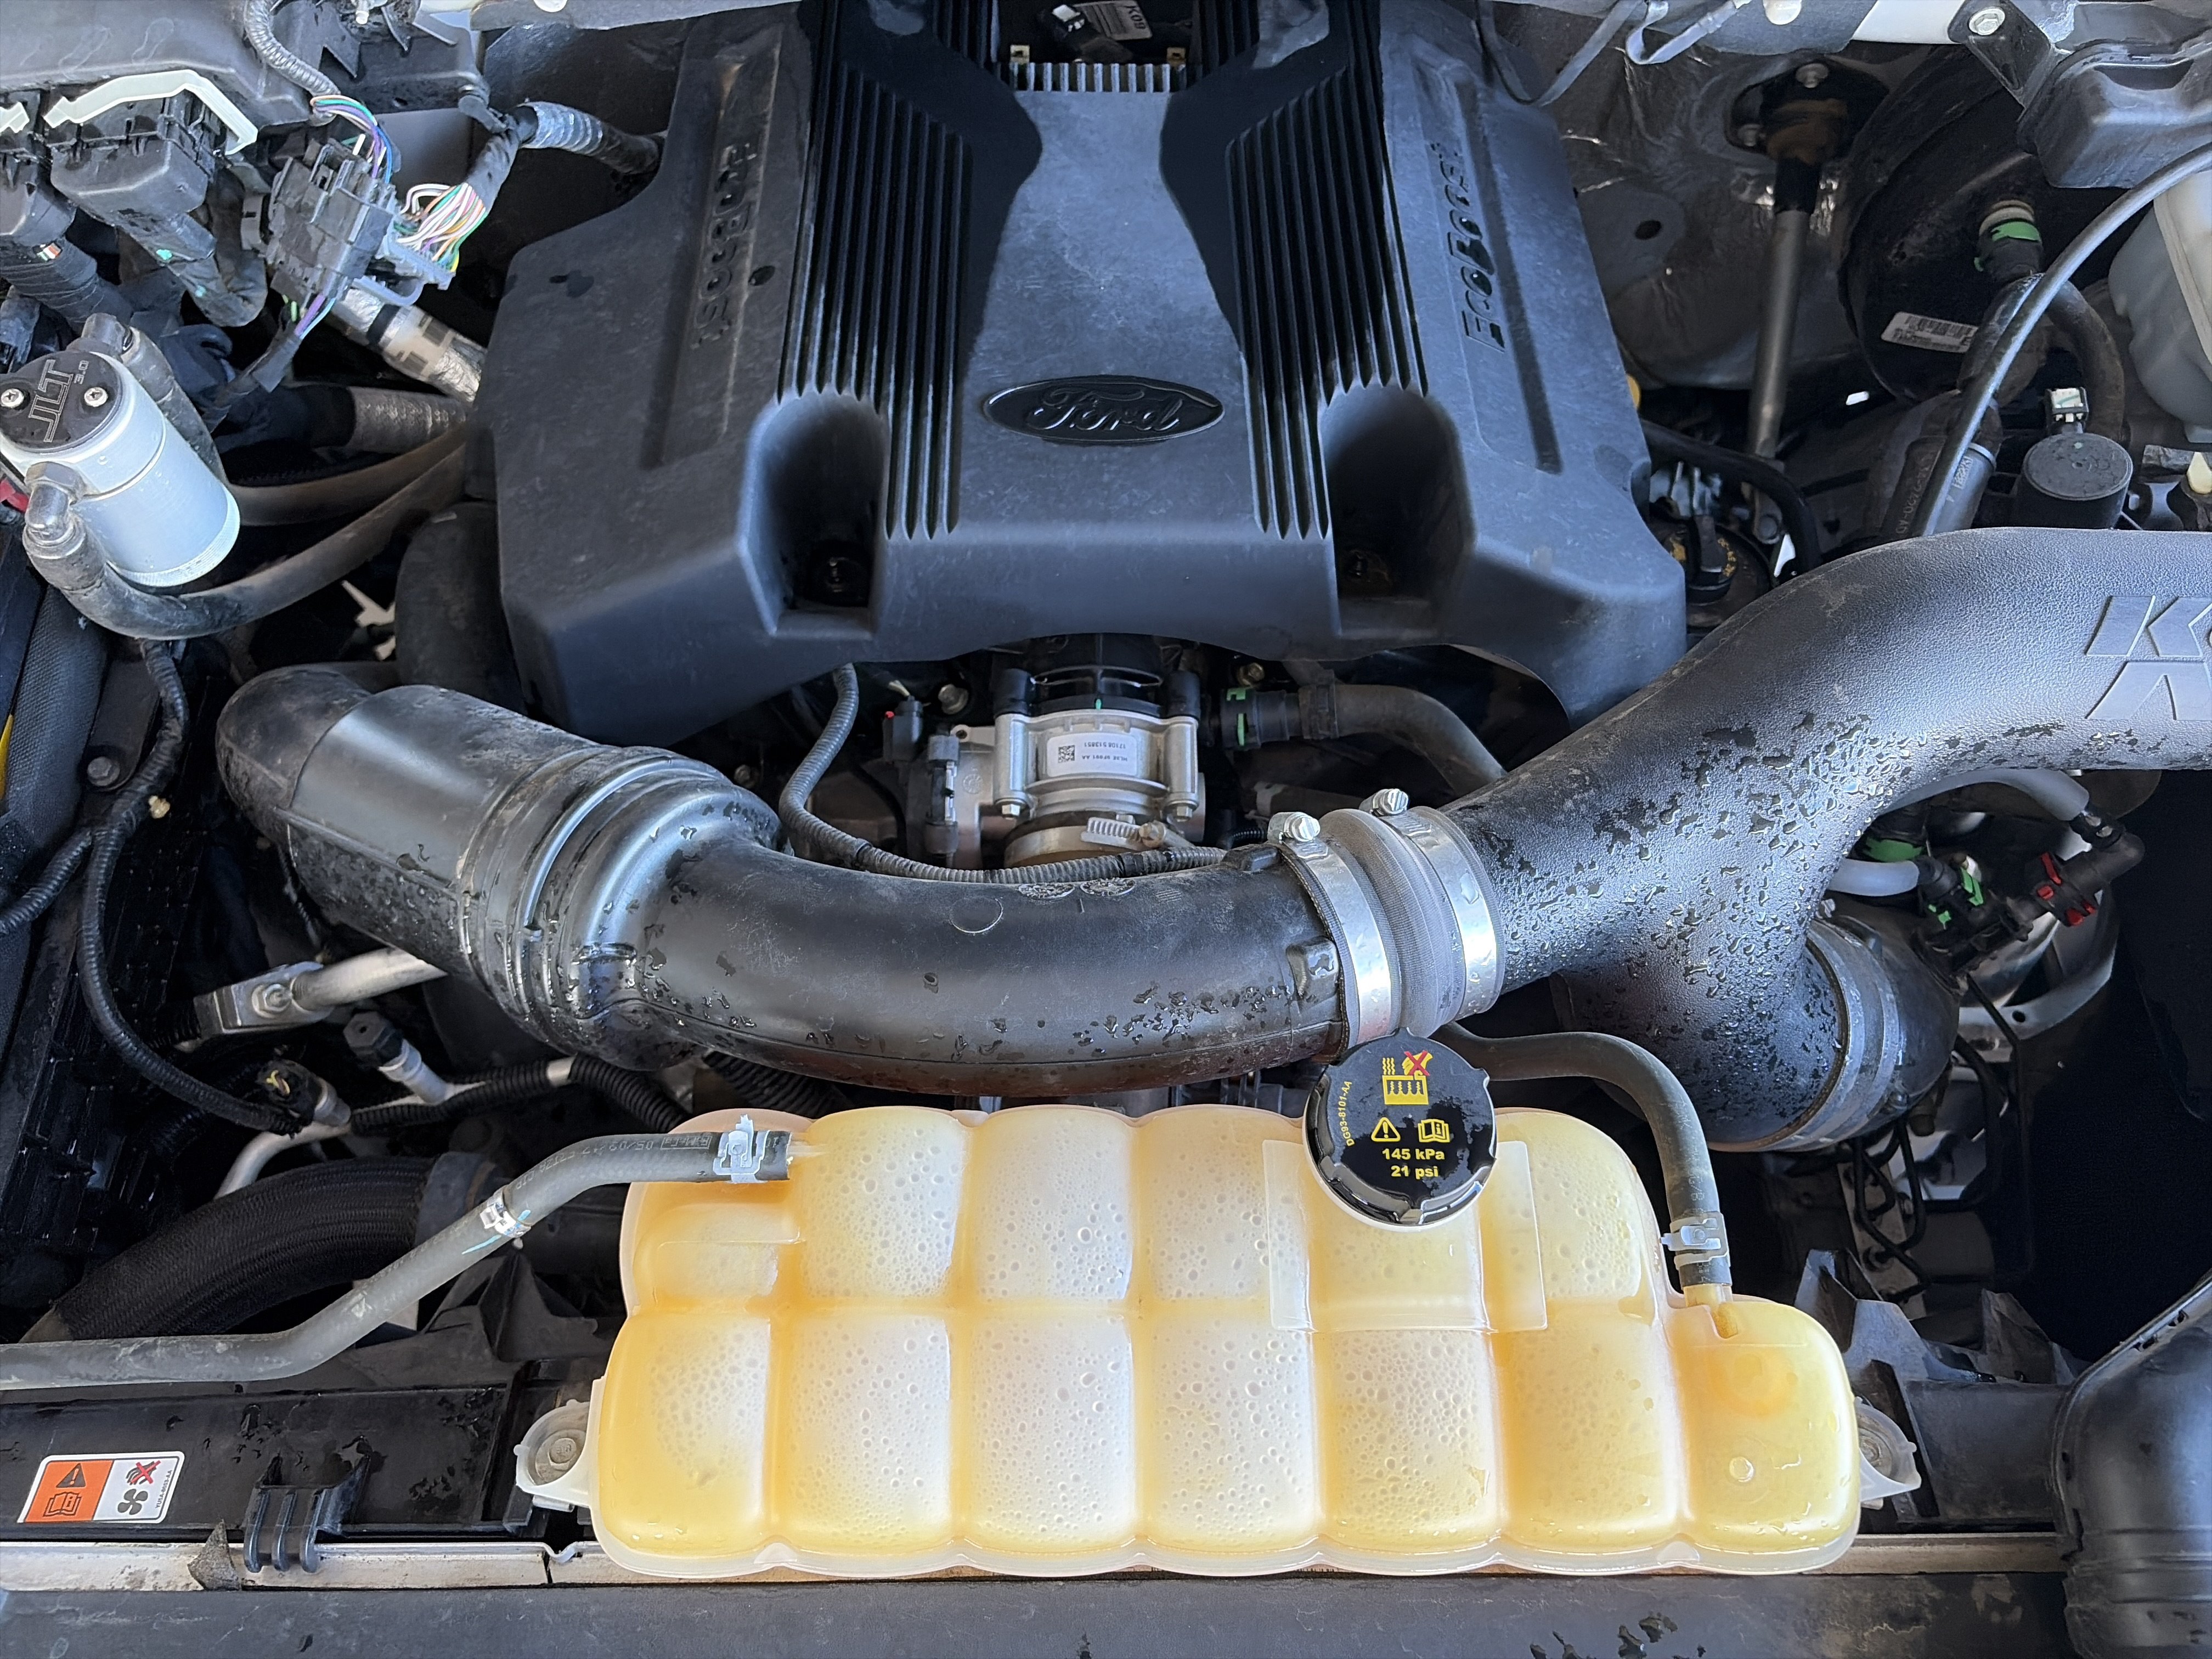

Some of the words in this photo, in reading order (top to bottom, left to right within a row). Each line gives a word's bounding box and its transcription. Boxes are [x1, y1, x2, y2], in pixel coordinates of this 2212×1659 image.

[74, 360, 89, 385] 3.0
[29, 359, 74, 442] JLT
[1026, 386, 1183, 431] Ford
[2083, 594, 2212, 658] K
[1338, 1081, 1355, 1147] DG93-8101-AA
[1382, 1148, 1412, 1160] 145
[1415, 1148, 1446, 1160] kPa
[1390, 1165, 1410, 1177] 21
[1415, 1165, 1439, 1180] psi
